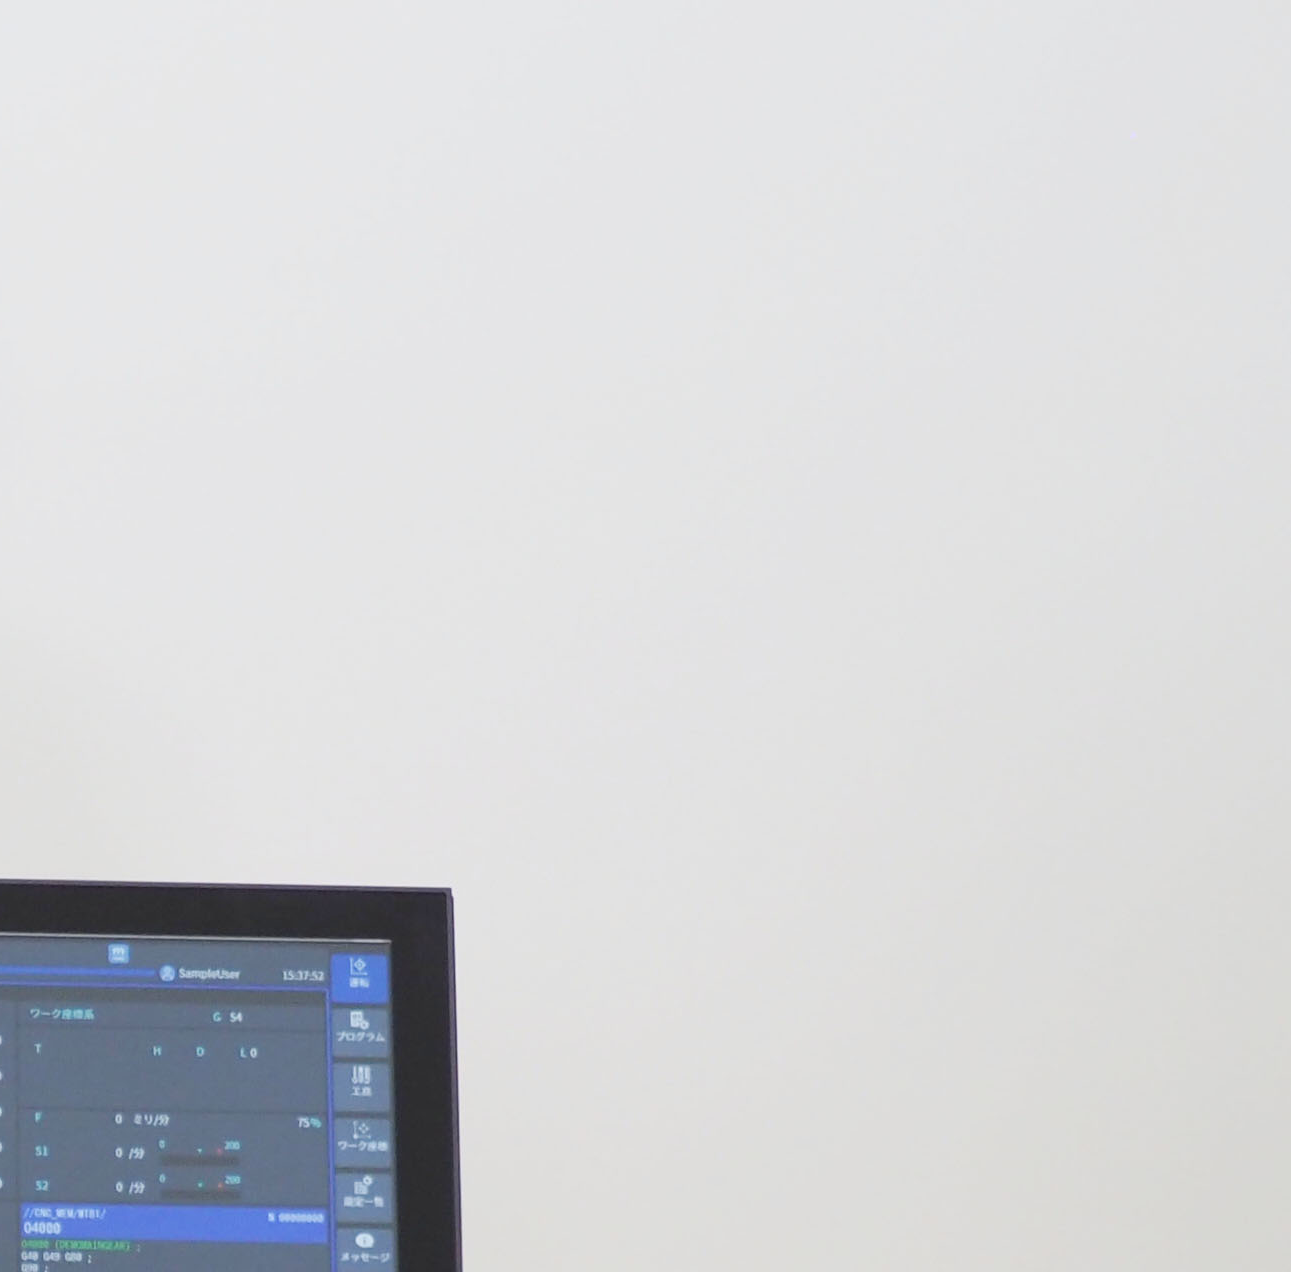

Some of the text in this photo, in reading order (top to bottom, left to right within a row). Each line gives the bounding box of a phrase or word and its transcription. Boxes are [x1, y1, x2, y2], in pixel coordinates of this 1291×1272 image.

[179, 968, 240, 980] SampleUser
[283, 970, 324, 981] 15:37:52
[213, 1012, 243, 1022] G 54
[337, 1031, 385, 1042] プログラム
[341, 1252, 390, 1263] メッセージ
